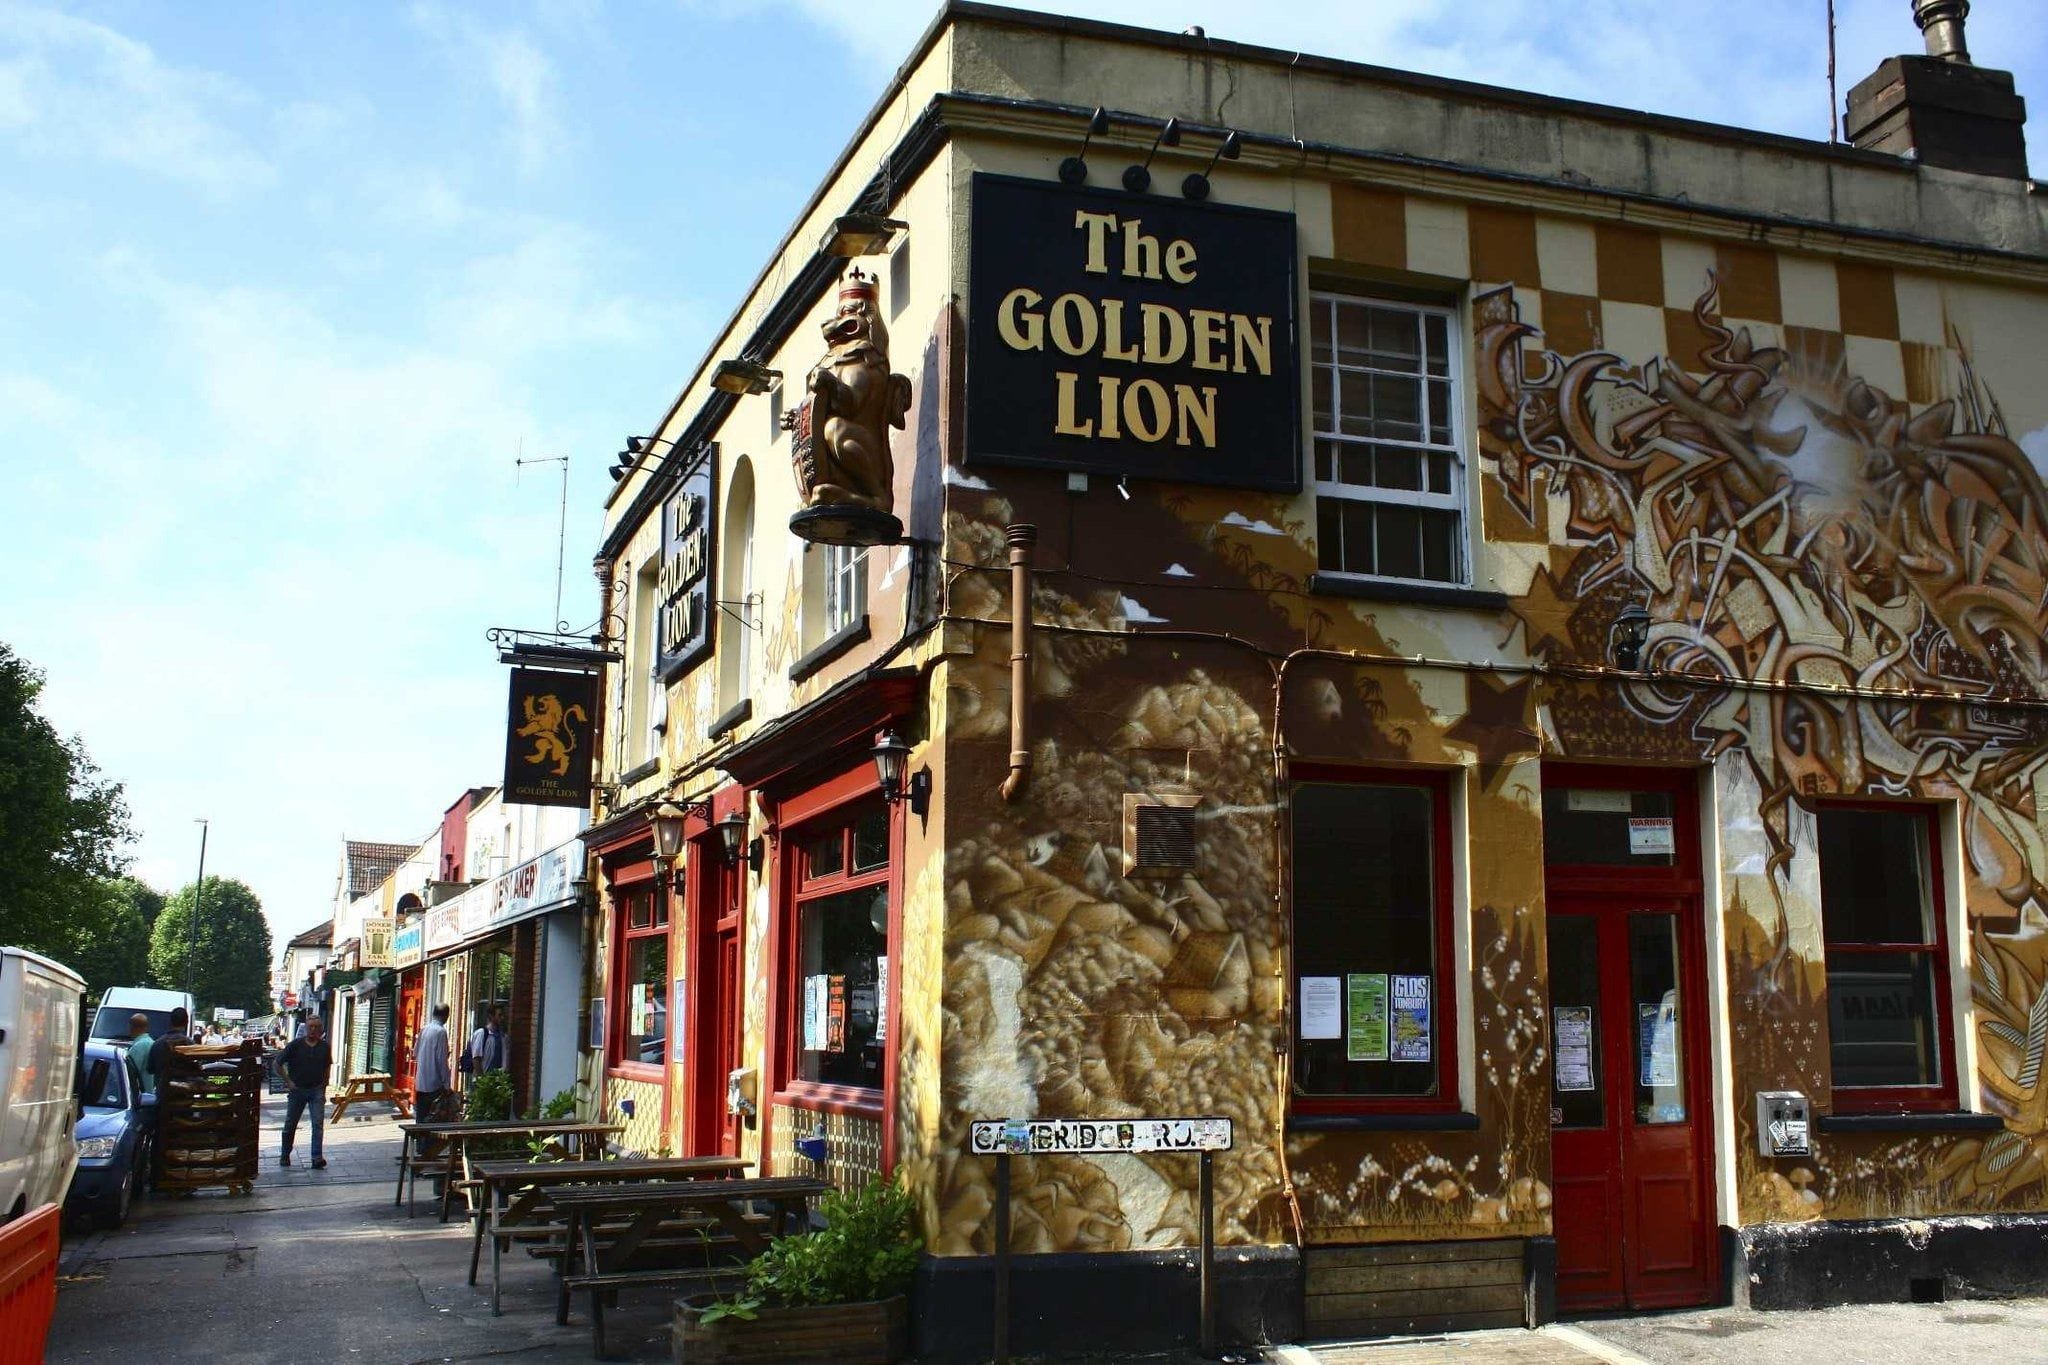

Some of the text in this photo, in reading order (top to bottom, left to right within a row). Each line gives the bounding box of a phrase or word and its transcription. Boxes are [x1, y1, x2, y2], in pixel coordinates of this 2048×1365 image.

[1075, 209, 1198, 284] The
[997, 288, 1272, 376] GOLDEN
[1055, 372, 1217, 448] LION
[673, 491, 693, 539] The
[659, 529, 704, 607] GOLDEN
[665, 592, 693, 653] LION
[516, 786, 578, 798] GOLDEN LION
[541, 779, 559, 788] THE
[1630, 819, 1672, 827] WARNING
[1395, 978, 1427, 997] GLOS
